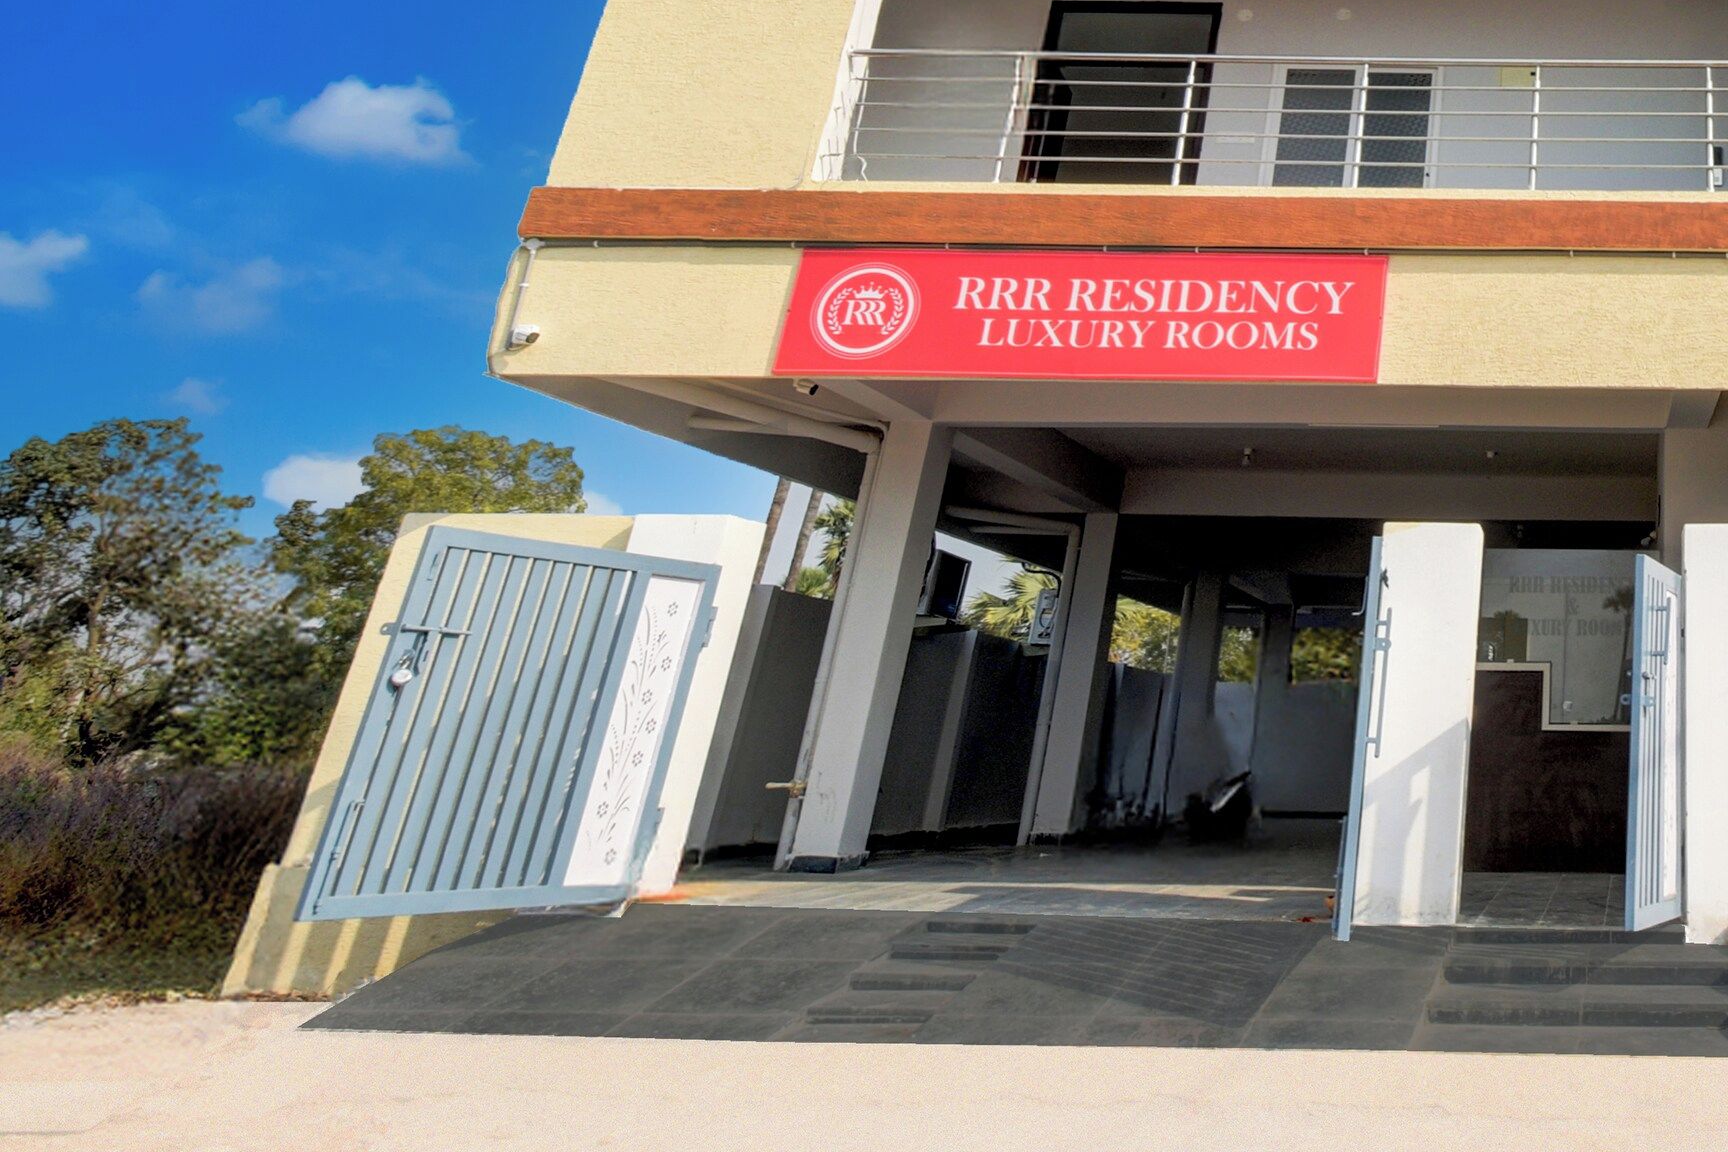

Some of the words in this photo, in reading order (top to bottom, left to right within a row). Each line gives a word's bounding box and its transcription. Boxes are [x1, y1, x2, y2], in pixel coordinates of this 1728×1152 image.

[954, 276, 1051, 311] RRR
[1065, 278, 1355, 315] RESIDENCY
[842, 299, 887, 326] RRR
[977, 318, 1156, 348] LUXURY
[1163, 320, 1319, 350] ROOMS
